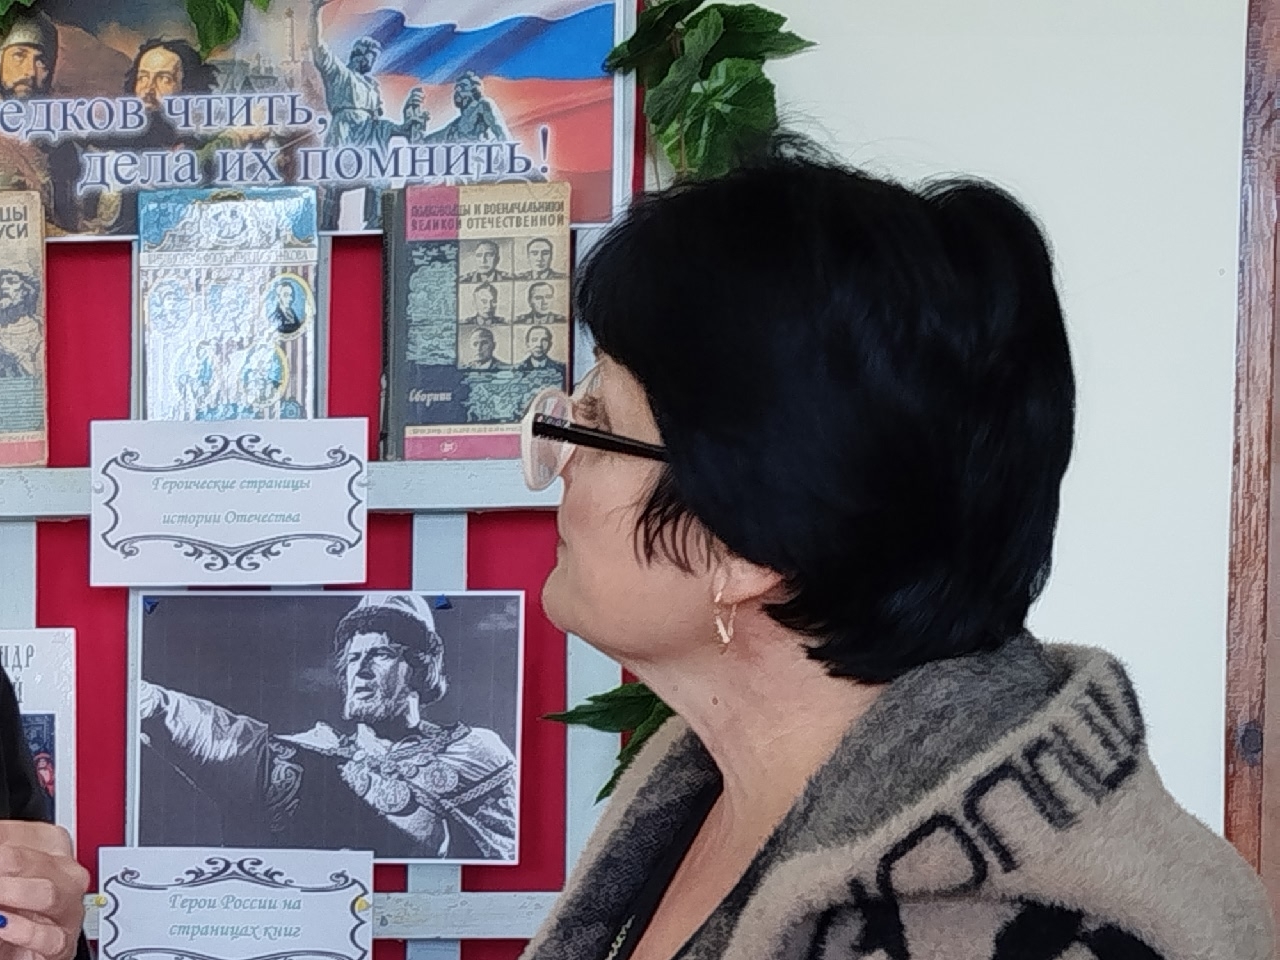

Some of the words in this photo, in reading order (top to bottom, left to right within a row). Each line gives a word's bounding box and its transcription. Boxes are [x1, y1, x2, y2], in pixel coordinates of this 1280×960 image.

[165, 92, 329, 134] чтить,
[78, 150, 201, 193] дела
[220, 149, 280, 181] их
[300, 126, 549, 180] помнить!
[411, 217, 461, 231] ВЕЛИКОЙ
[466, 213, 564, 229] ОТЕЧЕСТВЕННОЙ
[152, 476, 236, 494] Героические
[239, 478, 311, 493] страницы
[162, 512, 221, 527] истории
[224, 511, 301, 525] Отечества
[170, 894, 217, 914] Герои
[221, 894, 277, 910] России
[282, 898, 302, 910] на
[170, 924, 261, 941] страницах
[263, 925, 301, 941] книг
